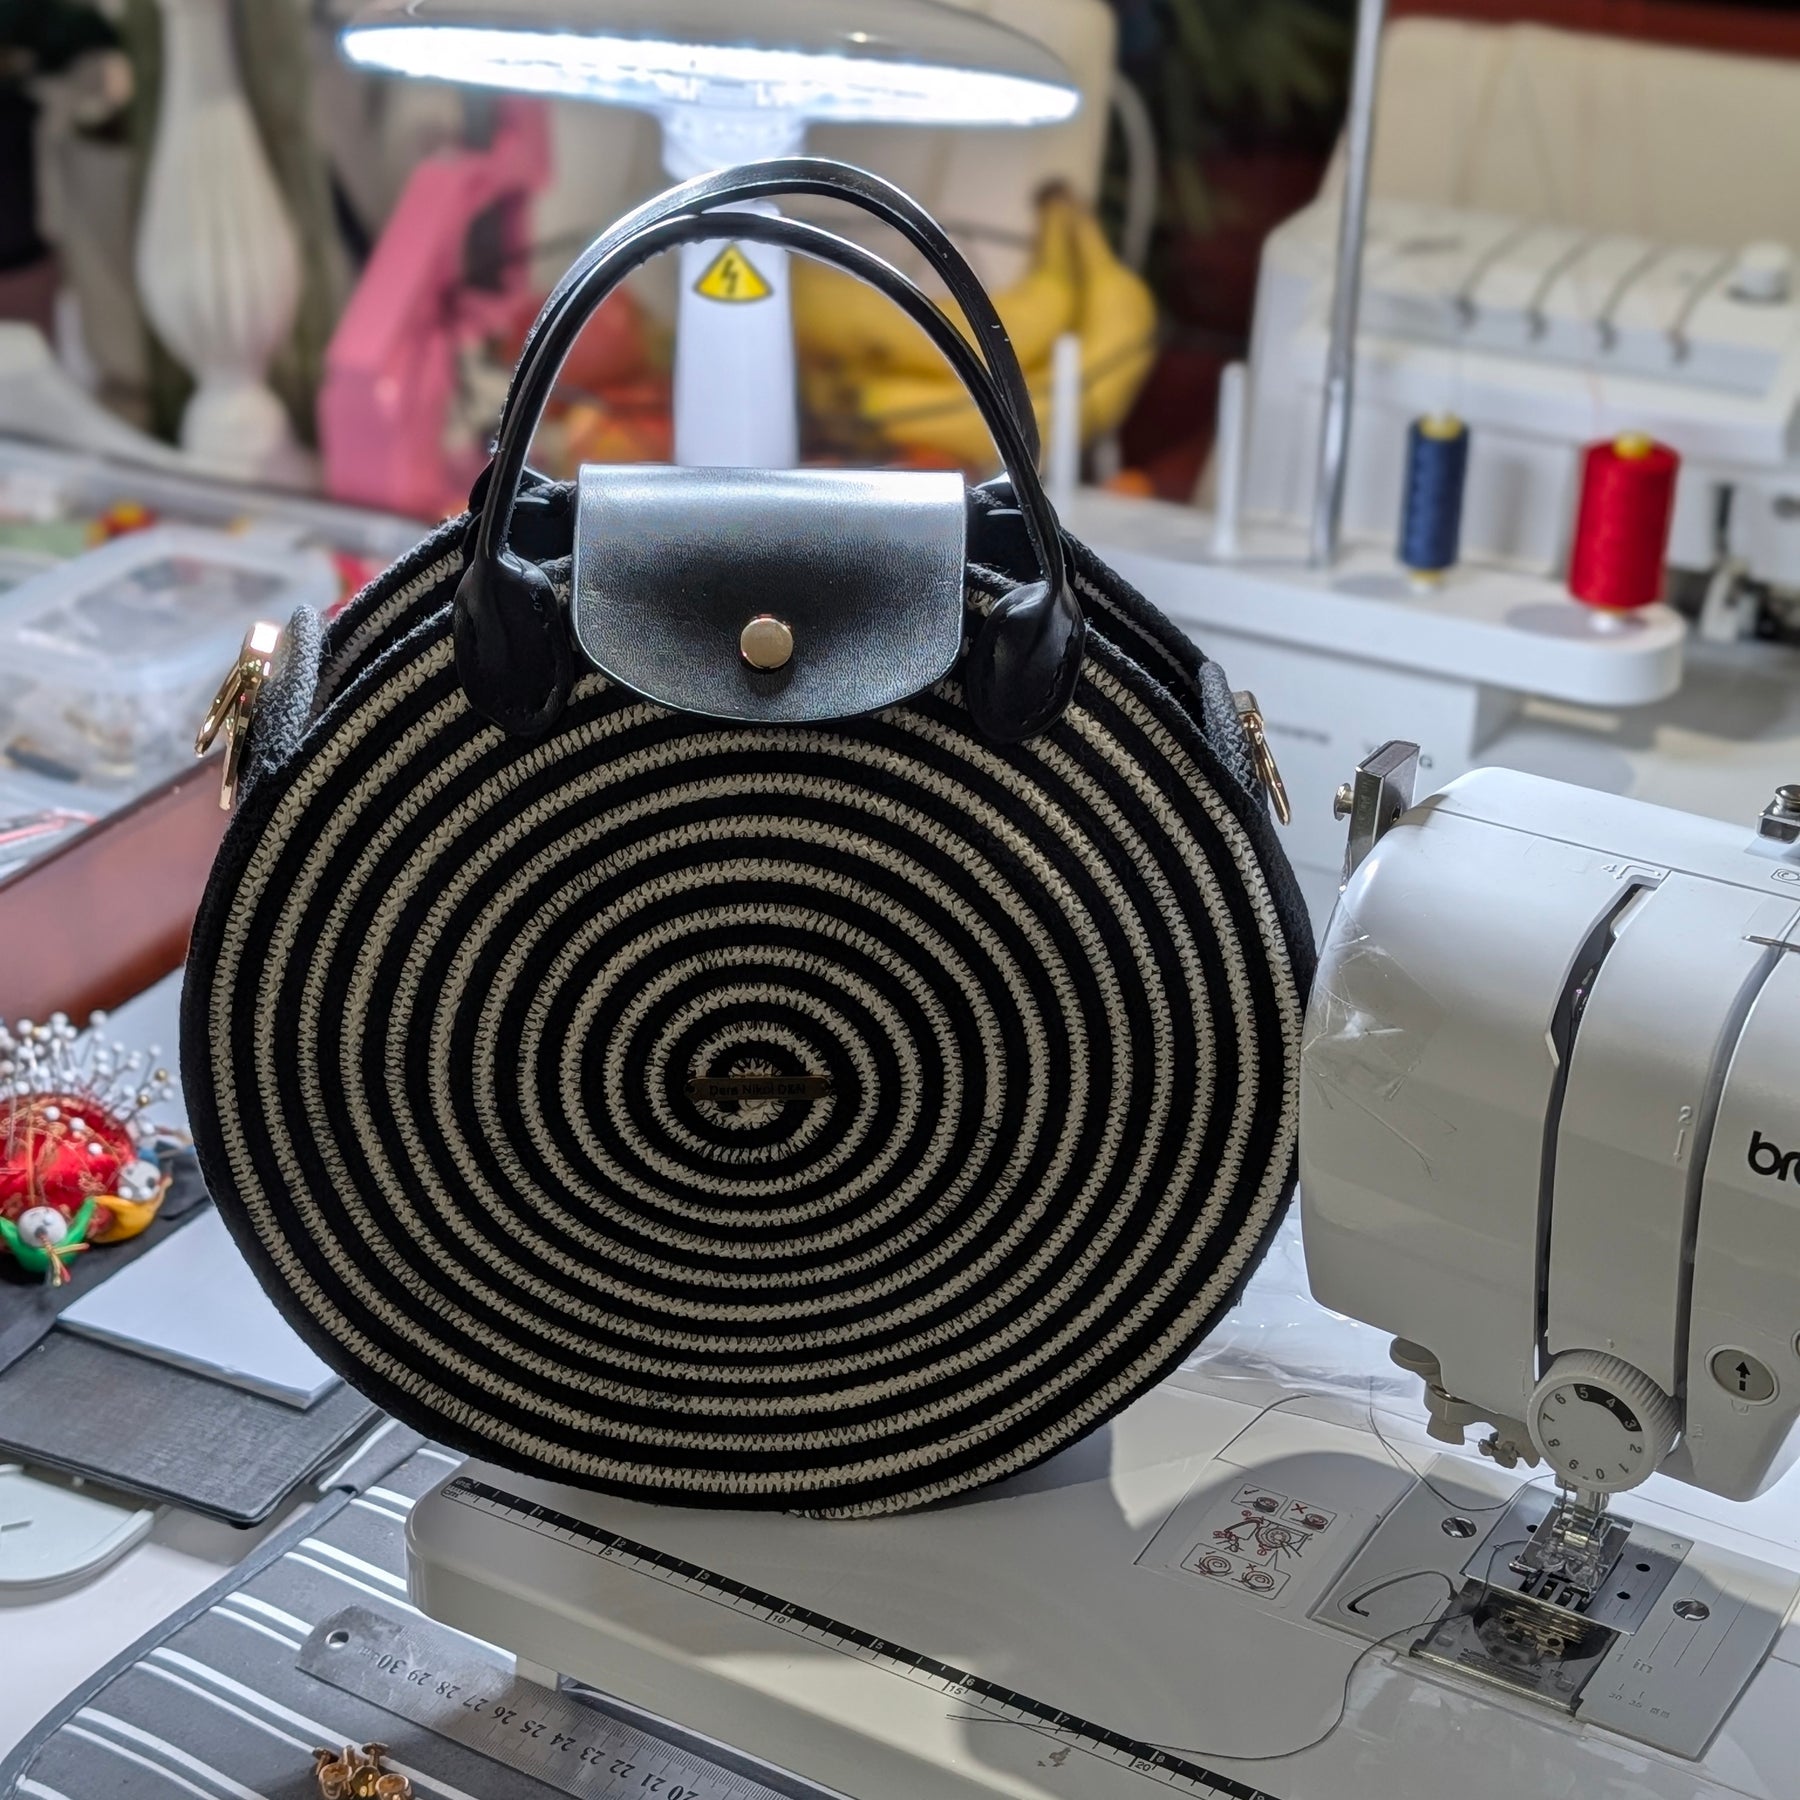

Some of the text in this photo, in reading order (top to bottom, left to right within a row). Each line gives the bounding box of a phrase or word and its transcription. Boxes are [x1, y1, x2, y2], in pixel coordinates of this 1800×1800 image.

[1748, 1130, 1800, 1184] br
[1542, 1387, 1642, 1480] 5 4 3 2 1 0 9 8 7 6
[1632, 1658, 1653, 1674] in
[407, 1669, 432, 1686] 29
[435, 1681, 461, 1699] 28
[772, 1614, 786, 1624] 10
[950, 1685, 963, 1695] 15
[1135, 1761, 1151, 1772] 20
[462, 1694, 488, 1712] 27
[490, 1706, 517, 1725] 26
[520, 1719, 547, 1738] 25
[550, 1733, 576, 1751] 24
[580, 1746, 606, 1765] 23
[609, 1759, 636, 1778] 22
[641, 1773, 667, 1792] 21
[667, 1785, 699, 1800] 20
